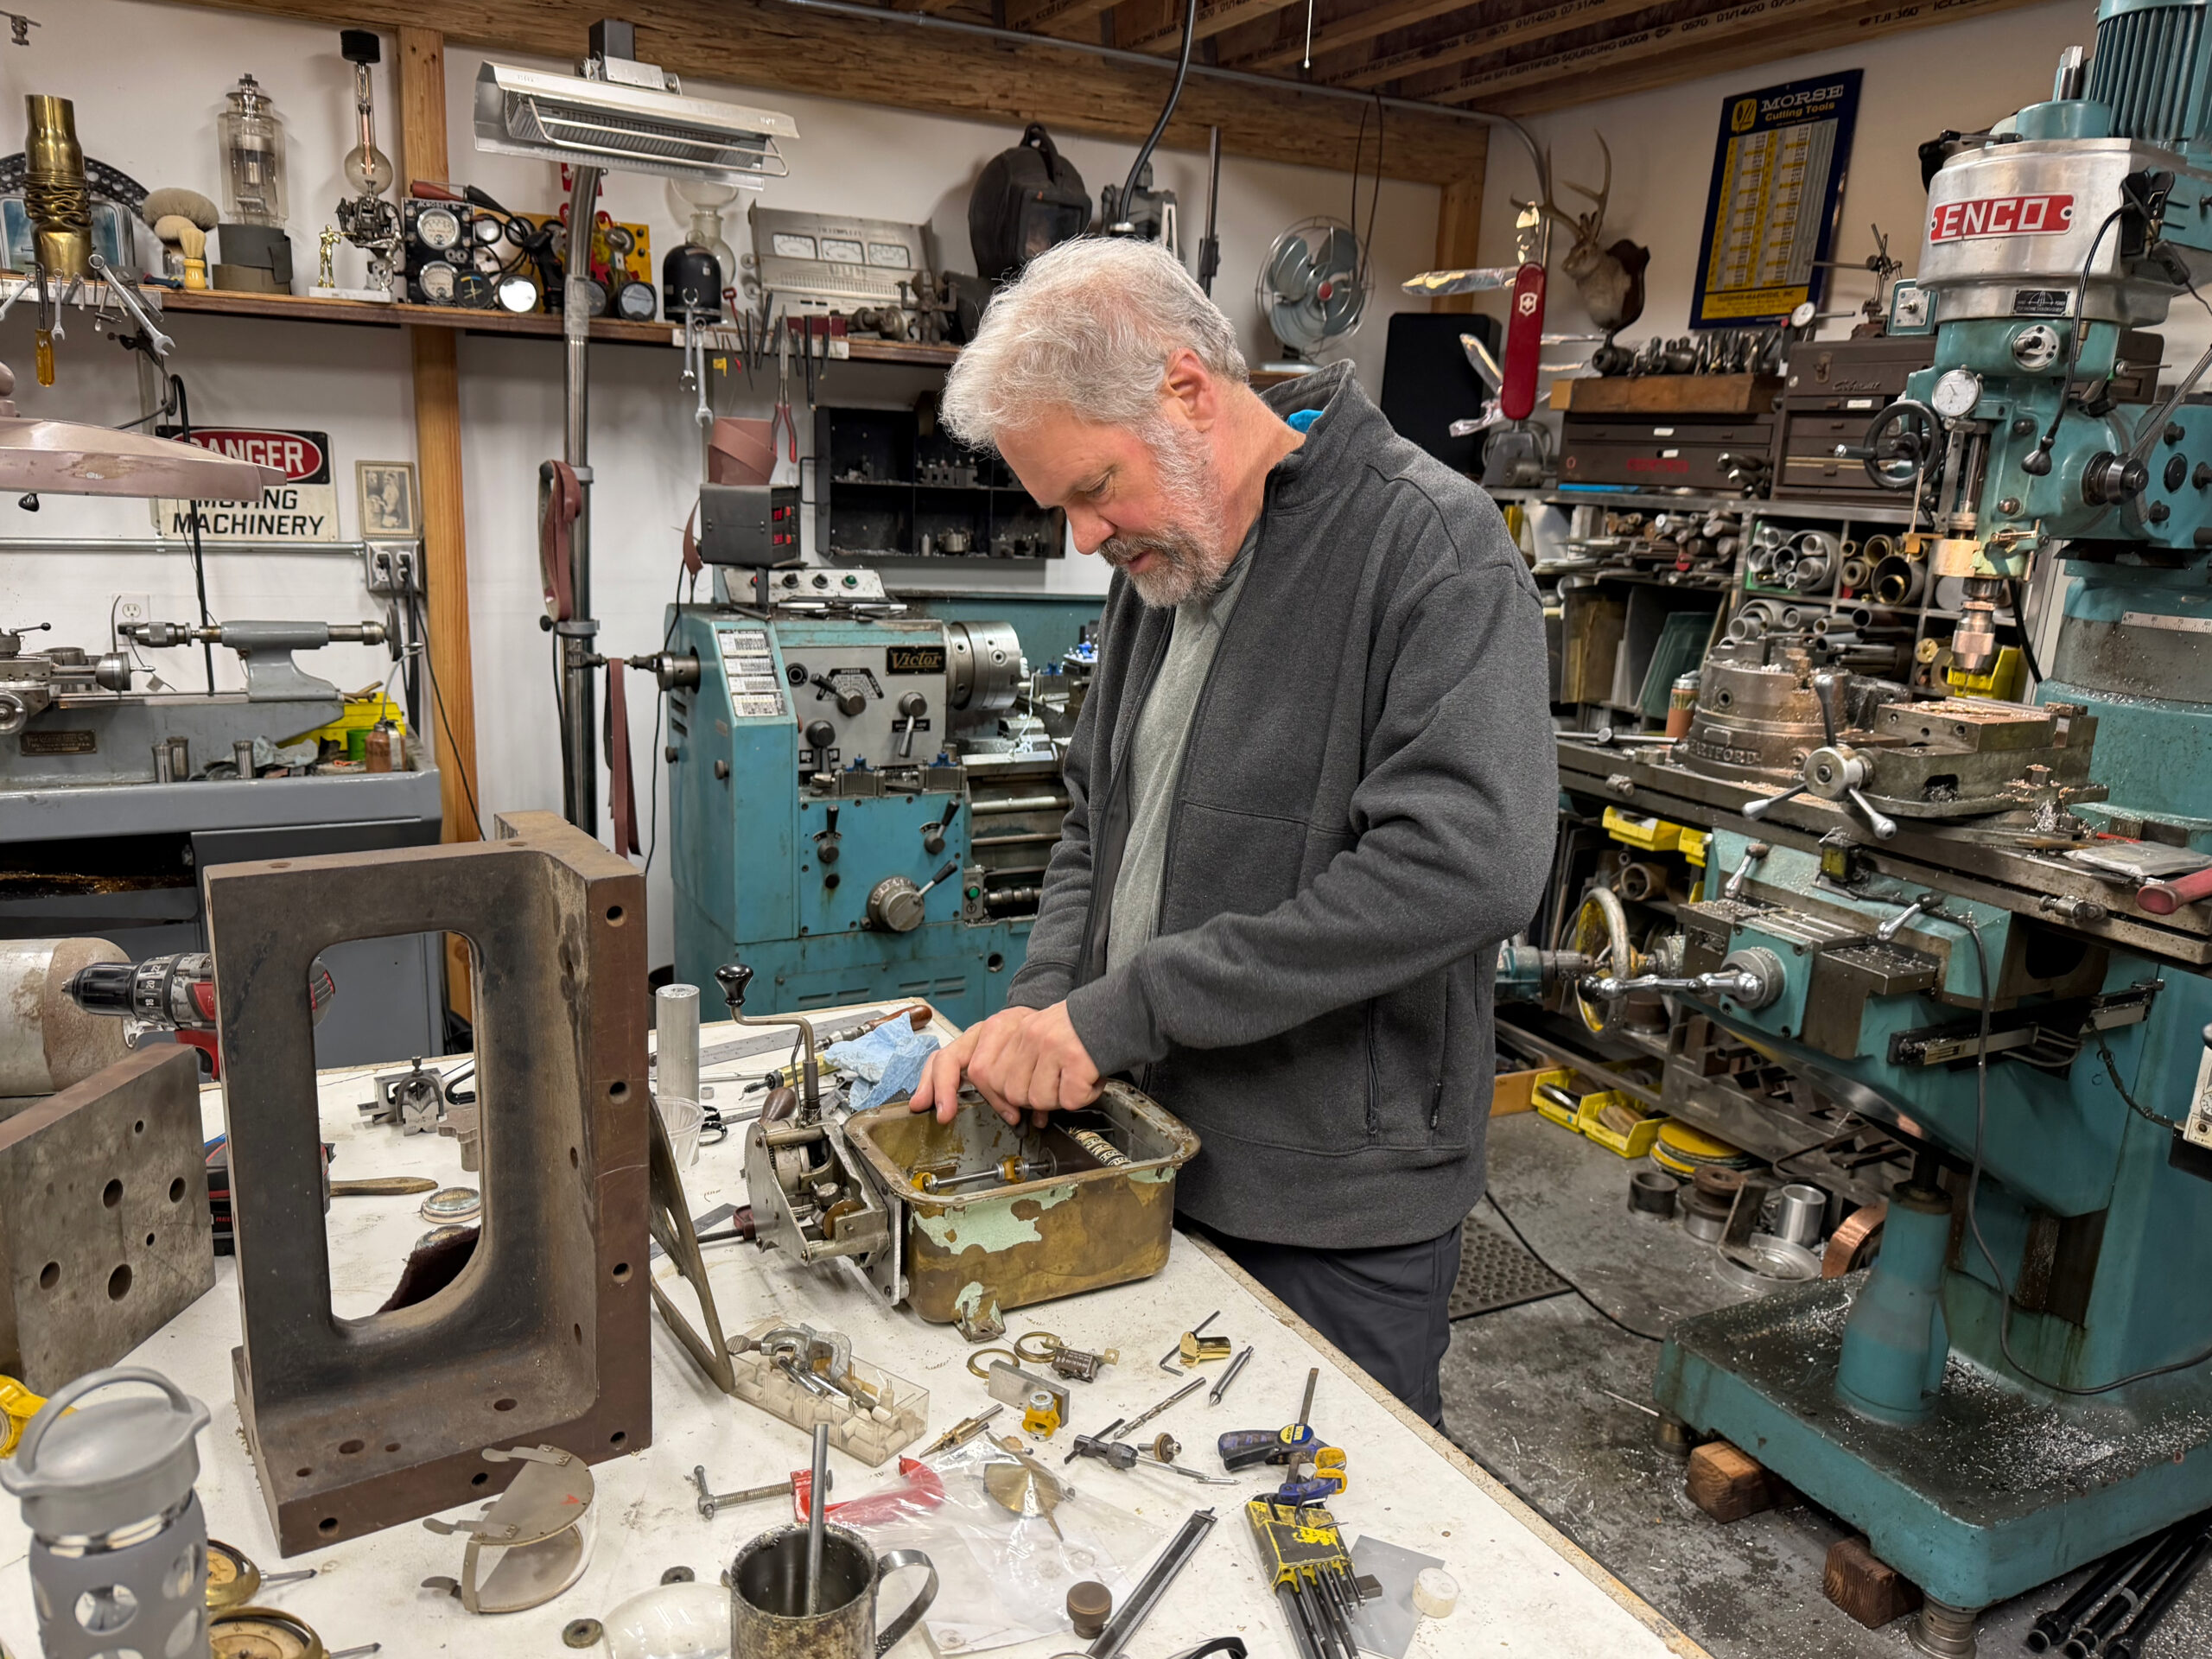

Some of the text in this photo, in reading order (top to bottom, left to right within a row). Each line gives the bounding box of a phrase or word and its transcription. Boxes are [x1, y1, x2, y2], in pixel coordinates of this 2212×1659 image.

[1561, 42, 1617, 63] SOURCING
[1681, 18, 1708, 32] 0570
[1761, 84, 1844, 112] MORSE
[1765, 108, 1803, 122] Cutting
[1806, 102, 1835, 114] Tools
[1941, 197, 2050, 238] ENCO
[173, 512, 325, 536] MACHINERY
[891, 651, 942, 669] Victor
